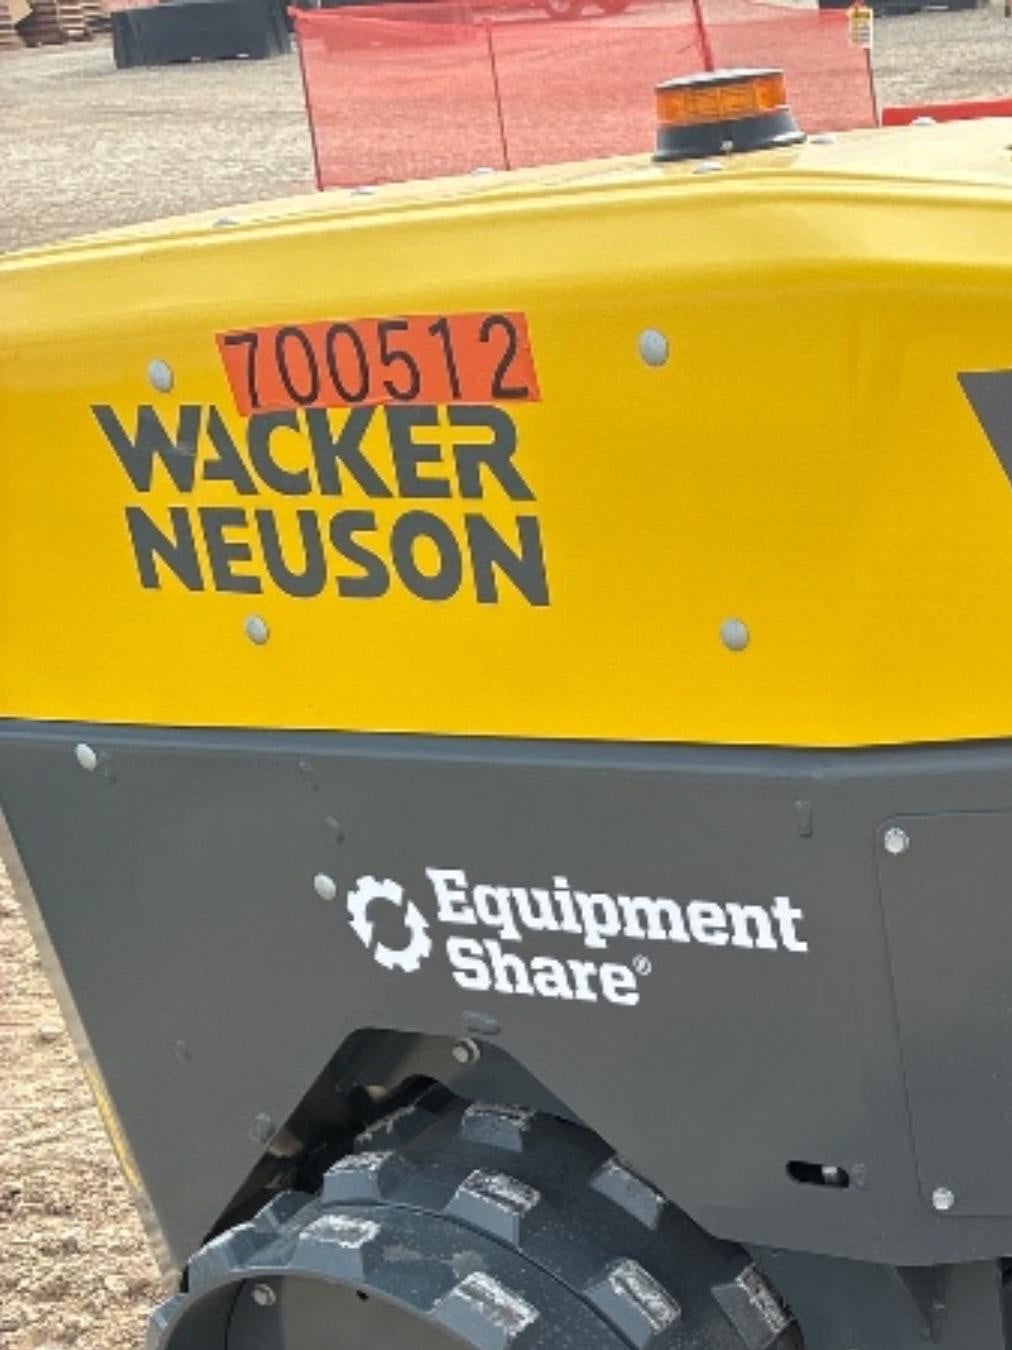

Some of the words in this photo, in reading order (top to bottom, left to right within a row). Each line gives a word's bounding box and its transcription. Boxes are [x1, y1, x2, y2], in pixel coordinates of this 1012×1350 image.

[222, 314, 531, 408] 700512
[92, 403, 537, 502] WACKER
[125, 506, 551, 606] NEUSON
[425, 866, 809, 954] Equipment
